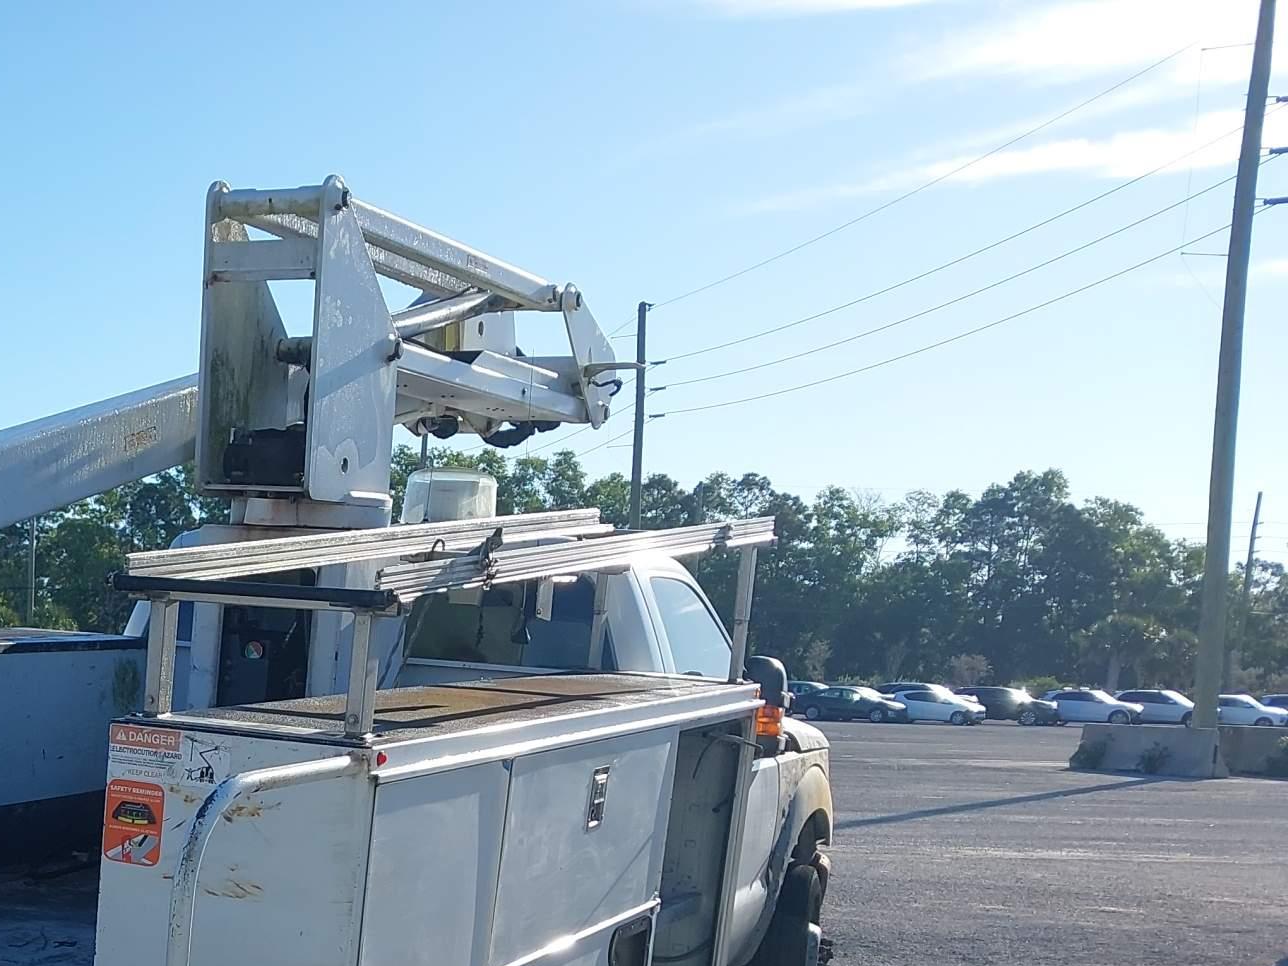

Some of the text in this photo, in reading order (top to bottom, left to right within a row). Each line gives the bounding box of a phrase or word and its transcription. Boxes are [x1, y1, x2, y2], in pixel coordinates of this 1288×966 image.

[129, 731, 175, 746] DANGER
[110, 745, 158, 758] ELECTROCUTION
[110, 784, 163, 797] SAFETY REMINDER
